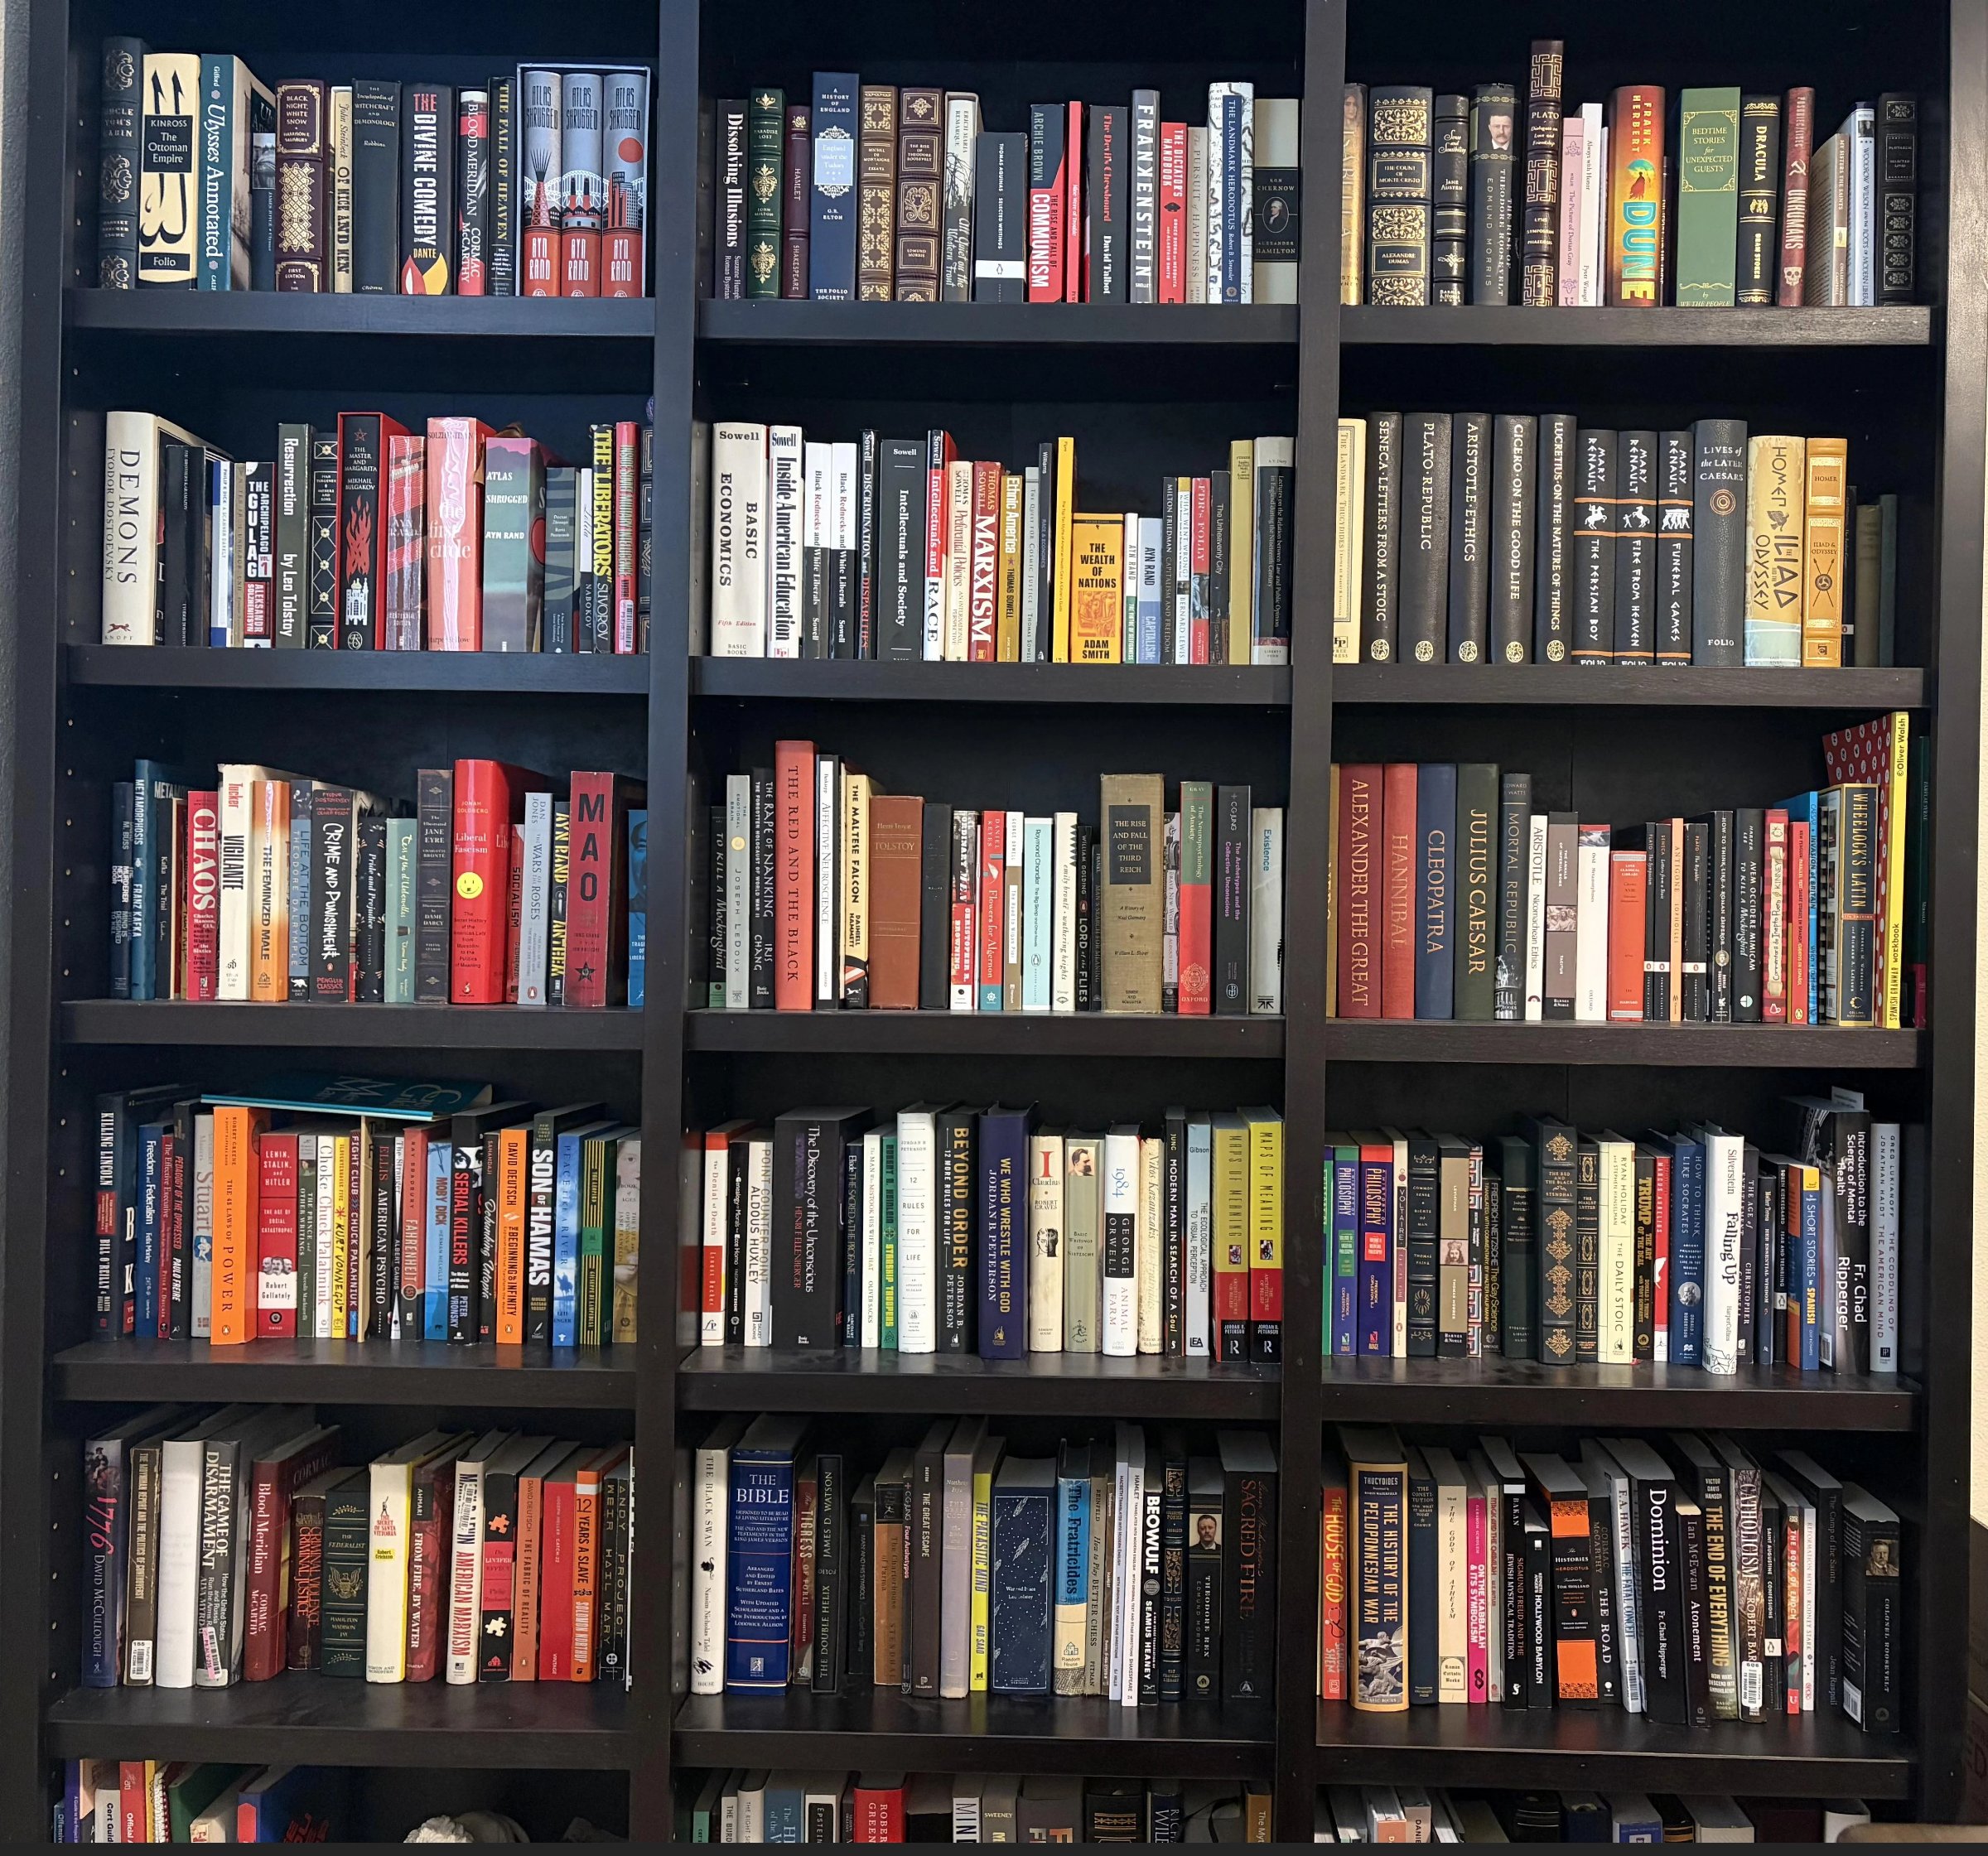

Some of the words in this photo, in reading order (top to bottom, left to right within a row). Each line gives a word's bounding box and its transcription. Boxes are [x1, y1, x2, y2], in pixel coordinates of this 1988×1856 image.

[413, 94, 437, 112] THE
[468, 104, 478, 148] BLOOD
[1632, 95, 1641, 152] HERBERT
[1643, 102, 1652, 145] FRANK
[148, 143, 188, 152] Ottoman
[161, 133, 176, 141] The
[207, 104, 225, 162] Ulysses
[413, 114, 437, 172] DIVINE
[723, 113, 744, 184] Dissolving
[1754, 126, 1767, 181] DRACULA
[152, 154, 183, 164] Empire
[1686, 155, 1733, 163] UNEXPECTED
[1694, 165, 1723, 173] GUESTS
[467, 151, 477, 216] MERIDIAN
[206, 166, 224, 258] Annotated
[413, 177, 437, 245] COMEDY
[726, 188, 743, 248] Illusions
[1785, 190, 1807, 249] UNHUMANS
[153, 257, 176, 267] Folio
[413, 248, 437, 258] DANTE
[1030, 194, 1050, 288] COMMUNISM
[1621, 201, 1657, 300] DUNE
[720, 431, 760, 441] Sowell
[284, 438, 298, 516] Resurrection
[776, 457, 797, 499] Inside
[118, 451, 140, 583] DEMONS
[720, 473, 732, 586] ECONOMICS
[746, 502, 758, 559] BASIC
[776, 502, 797, 571] American
[899, 489, 909, 566] Intellectuals
[280, 554, 297, 568] by
[1080, 555, 1115, 565] WEALTH
[1089, 543, 1105, 553] THE
[1093, 566, 1103, 576] OF
[282, 570, 297, 591] Leo
[899, 567, 908, 586] and
[972, 516, 996, 643] MARXISM
[1078, 579, 1116, 588] NATIONS
[279, 594, 297, 637] Tolstoy
[596, 583, 609, 640] SUVOROV
[774, 572, 796, 641] Education
[894, 588, 907, 627] Society
[927, 581, 939, 642] RACE
[1082, 650, 1109, 659] SMITH
[1084, 640, 1108, 648] ADAM
[229, 783, 244, 808] Tucker
[789, 765, 799, 799] THE
[135, 779, 144, 846] METAMORPHOSIS
[789, 805, 799, 839] RED
[851, 807, 860, 855] MALTESE
[1850, 793, 1870, 866] WHEELOCK'S
[192, 808, 216, 910] CHAOS
[322, 823, 344, 865] CRIME
[456, 832, 486, 842] Liberal
[577, 793, 605, 901] MAO
[875, 841, 914, 851] TOLSTOY
[1263, 829, 1271, 871] Existence
[1352, 779, 1369, 897] ALEXANDER
[1469, 809, 1487, 884] JULIUS
[1508, 813, 1519, 872] MORTAL
[222, 835, 244, 890] VIGILANTE
[326, 867, 339, 888] AND
[789, 846, 799, 881] AND
[133, 884, 142, 910] FRANZ
[261, 869, 272, 926] FEMINIZED
[511, 866, 520, 928] SOCIALISM
[788, 888, 799, 921] THE
[1391, 834, 1408, 949] HANNIBAL
[1426, 830, 1445, 953] CLEOPATRA
[1851, 873, 1866, 908] LATIN
[133, 911, 142, 937] KAFKA
[322, 890, 340, 960] PUNISHMENT
[1352, 899, 1368, 938] THE
[1469, 889, 1486, 974] CAESAR
[1505, 881, 1518, 953] REPUBLIC
[261, 929, 271, 960] MALE
[788, 928, 798, 981] BLACK
[1352, 942, 1368, 1006] GREAT
[101, 1112, 113, 1147] KILLING
[100, 1150, 113, 1186] LINCOLN
[265, 1178, 290, 1186] HITLER
[319, 1145, 333, 1190] Choke
[533, 1150, 553, 1192] SON
[953, 1127, 969, 1200] BEYOND
[1112, 1169, 1129, 1198] 1984
[1727, 1149, 1738, 1195] Silverstein
[436, 1177, 447, 1202] MOBY
[454, 1172, 469, 1211] SERIAL
[537, 1194, 546, 1205] OF
[750, 1186, 761, 1236] ALDOUS
[1365, 1169, 1382, 1225] PHILOSOPHY
[1638, 1178, 1653, 1225] TRUMP
[319, 1197, 332, 1236] Chuck
[377, 1188, 388, 1252] AMERICAN
[435, 1205, 447, 1226] DICK
[452, 1213, 468, 1265] KILLERS
[953, 1208, 968, 1268] ORDER
[1720, 1212, 1739, 1261] Falling
[528, 1208, 552, 1285] HAMAS
[748, 1239, 759, 1284] HUXLEY
[1108, 1217, 1117, 1273] ORWELL
[1122, 1218, 1130, 1274] GEORGE
[318, 1241, 331, 1305] Palahniuk
[375, 1255, 387, 1304] PSYCHO
[1723, 1262, 1736, 1285] Up
[1837, 1257, 1850, 1330] Ripperger
[1807, 1287, 1815, 1324] SPANISH
[258, 1483, 271, 1514] Blood
[705, 1483, 714, 1514] BLACK
[736, 1489, 789, 1503] BIBLE
[749, 1475, 776, 1485] THE
[1364, 1477, 1398, 1486] THUCYDIDES
[86, 1497, 118, 1555] 1776
[202, 1451, 219, 1569] DISARMAMENT
[922, 1503, 930, 1529] GREAT
[1740, 1483, 1759, 1579] CATHOLICISM
[254, 1517, 270, 1574] Meridian
[921, 1532, 929, 1558] ESCAPE
[1146, 1496, 1160, 1574] BEOWULF
[1363, 1502, 1379, 1594] PELOPONNESIAN
[1650, 1488, 1671, 1592] Dominion
[453, 1551, 475, 1603] AMERICAN
[451, 1607, 472, 1656] MARXISM
[1364, 1598, 1378, 1624] WAR
[1691, 1600, 1701, 1662] Atonement
[1143, 1641, 1151, 1680] HEANEY
